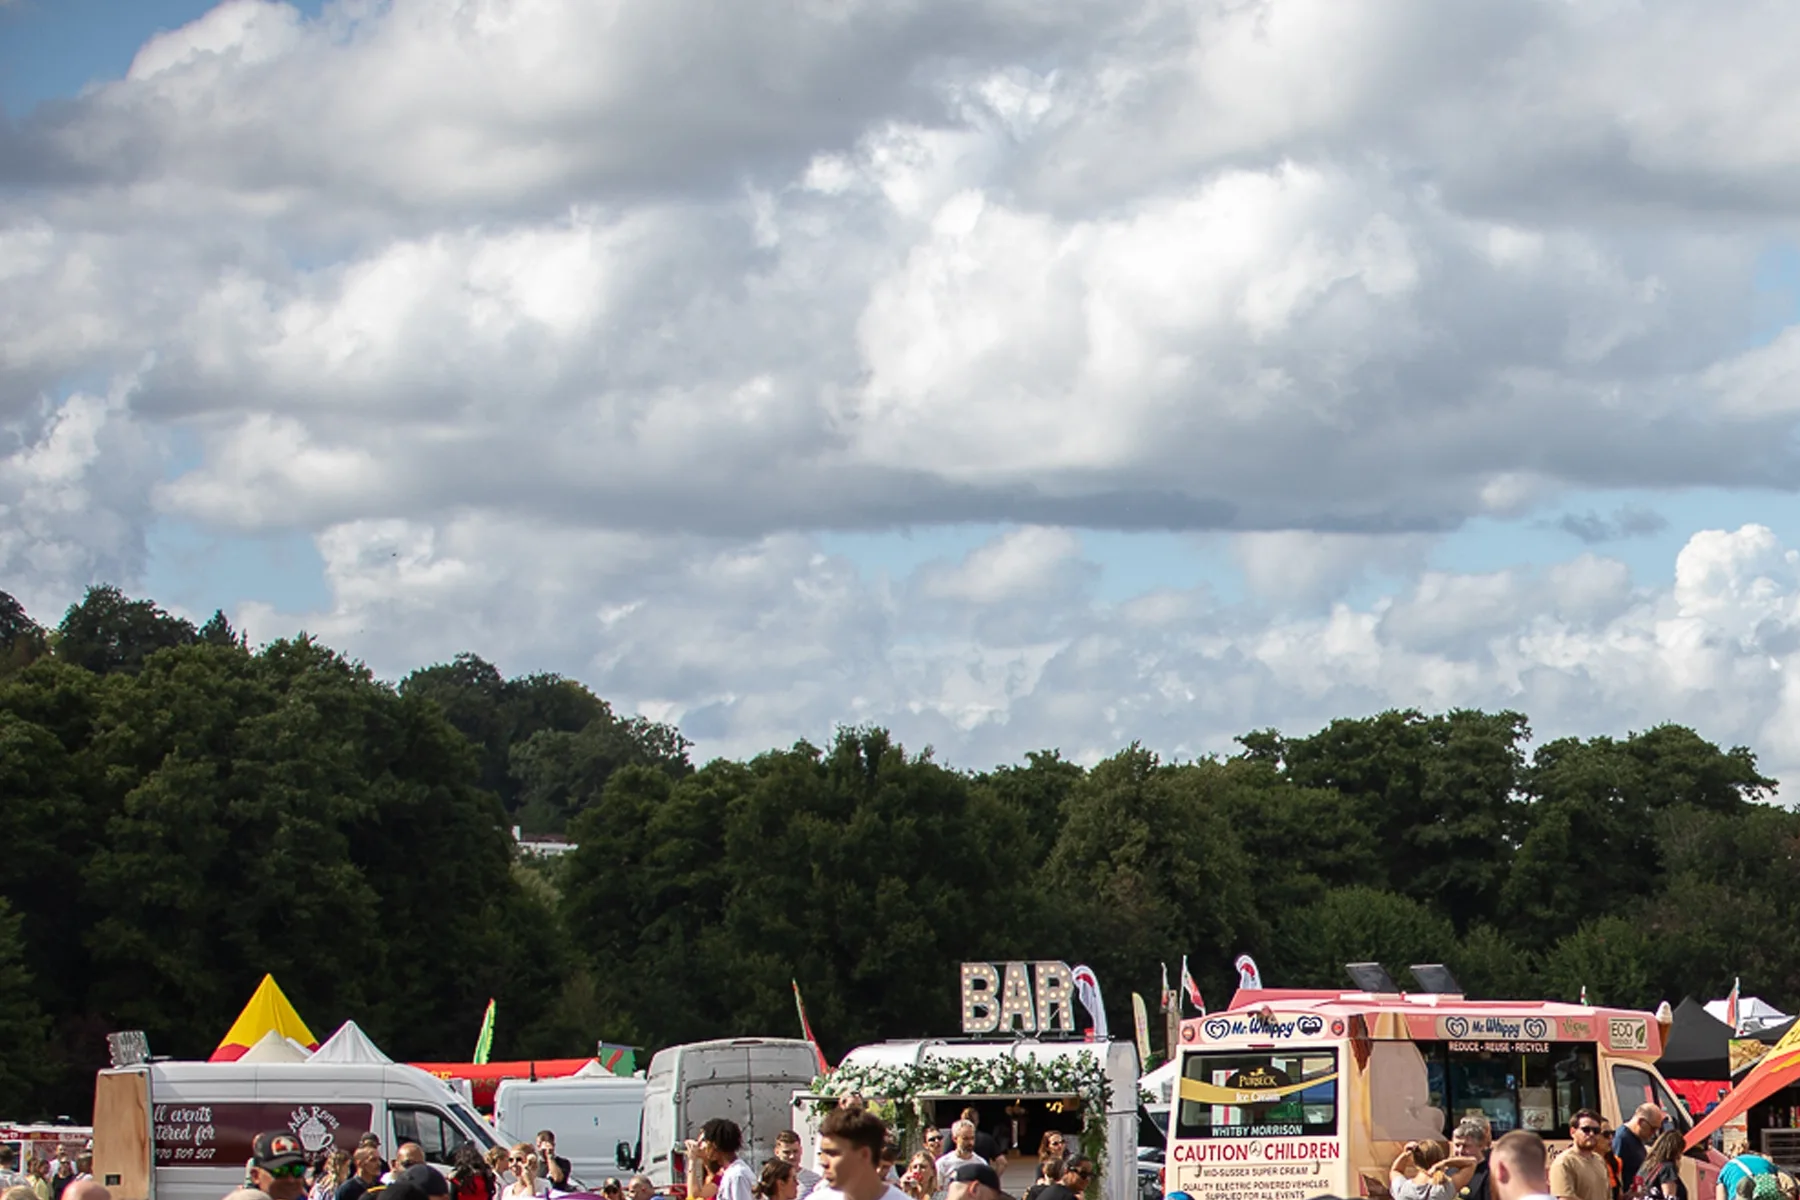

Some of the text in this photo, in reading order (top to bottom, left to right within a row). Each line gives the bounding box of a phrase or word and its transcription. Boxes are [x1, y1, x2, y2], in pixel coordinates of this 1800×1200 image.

[961, 961, 1075, 1033] BAR
[1611, 1023, 1633, 1037] ECO
[1449, 1041, 1550, 1053] REDUCE REUSE RECYCLE
[1236, 1092, 1281, 1102] Ice Cream
[154, 1105, 213, 1122] ll events
[155, 1124, 215, 1146] tered for
[1212, 1125, 1303, 1137] WHITBY MORRISON
[1174, 1142, 1340, 1162] CAUTION CHILDREN
[1203, 1166, 1308, 1178] MID-SUSSEX SUPER CREAM
[1183, 1179, 1329, 1192] QUALITY ELECTRIC POWERED VEHICLES
[1243, 1192, 1259, 1200] FOR
[1275, 1191, 1305, 1200] EVENTS
